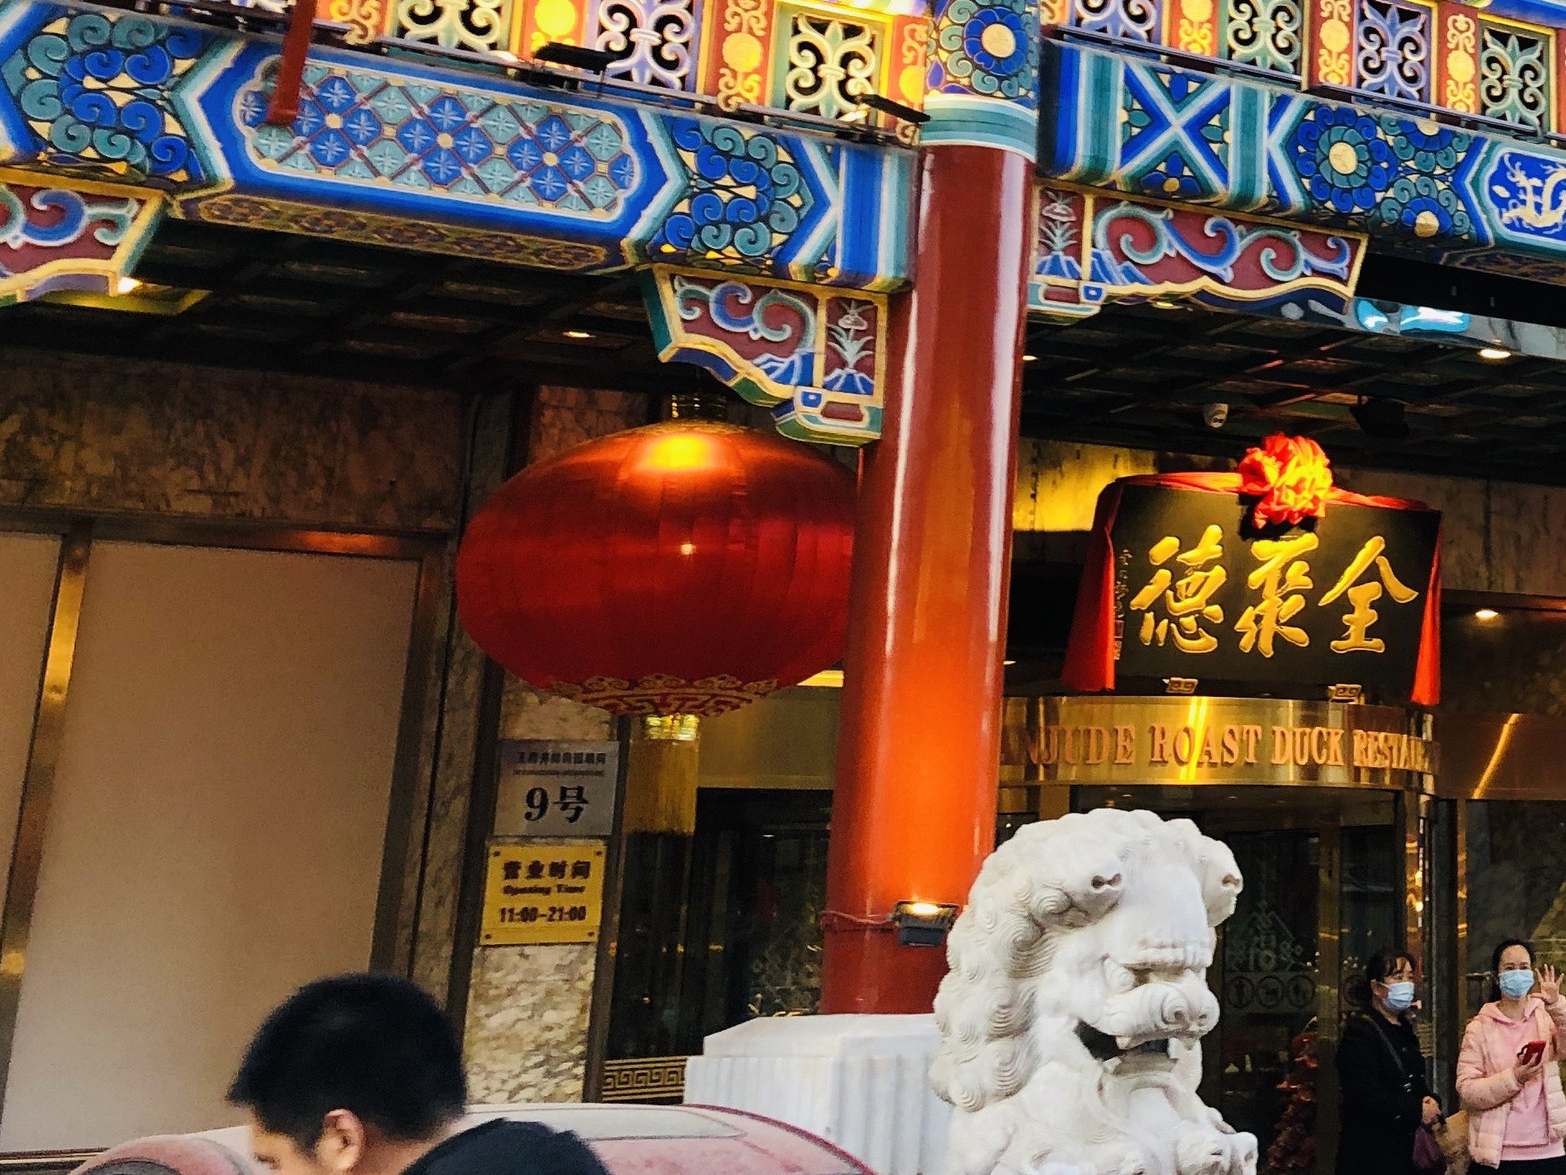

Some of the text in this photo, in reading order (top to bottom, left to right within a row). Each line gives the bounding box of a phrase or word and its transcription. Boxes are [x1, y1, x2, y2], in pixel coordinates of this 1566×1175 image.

[1130, 524, 1419, 658] 全聚德
[1150, 724, 1262, 767] ROAST
[1270, 727, 1345, 767] DUCK
[524, 785, 590, 823] 9号
[503, 860, 592, 880] 营业时间
